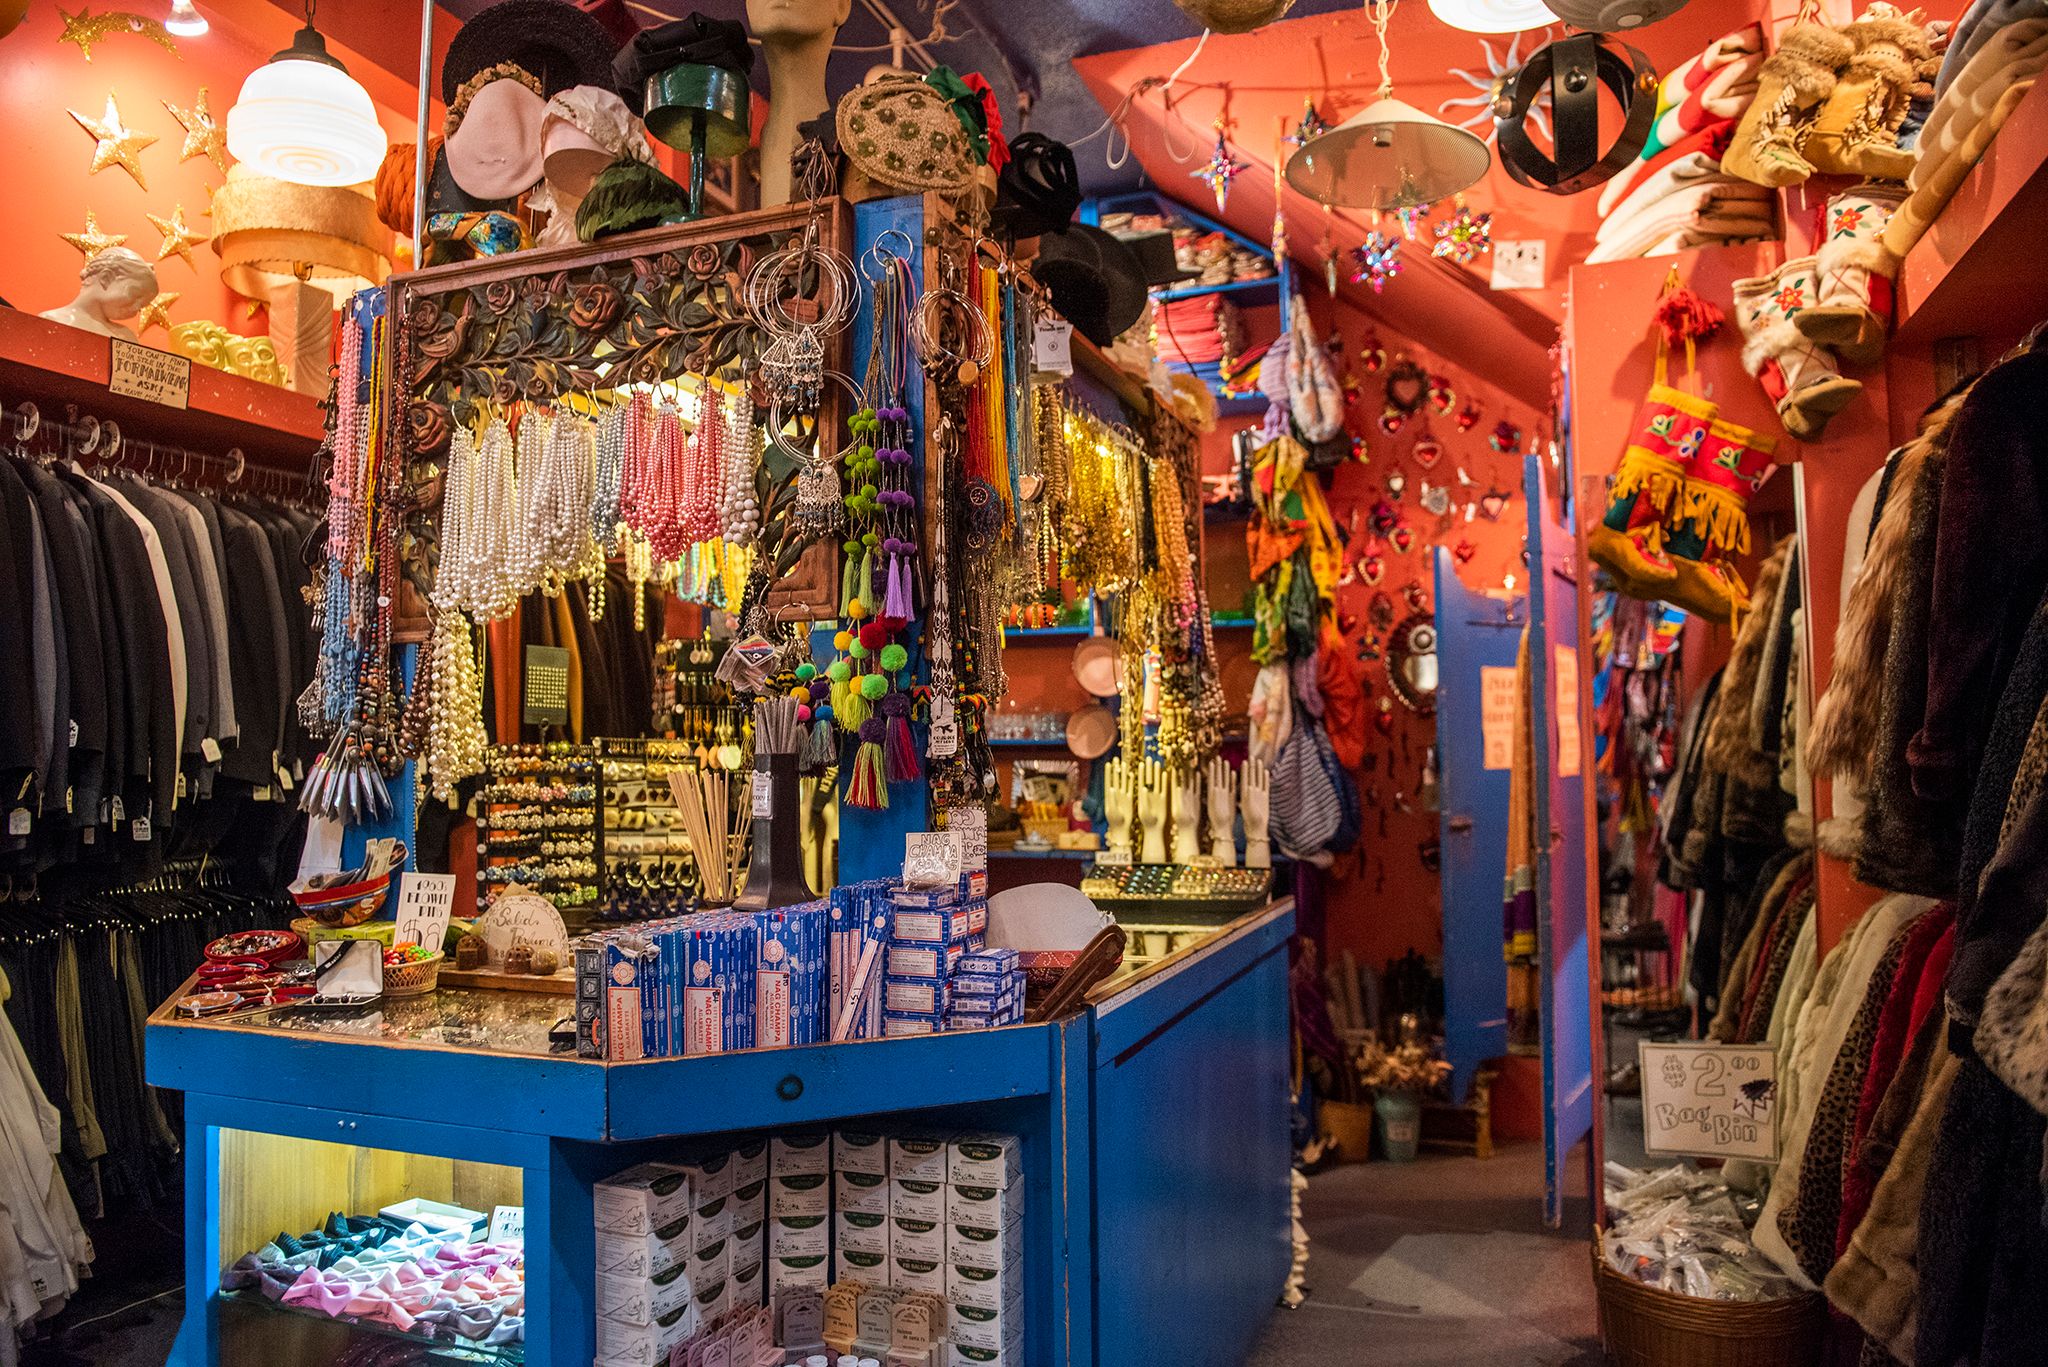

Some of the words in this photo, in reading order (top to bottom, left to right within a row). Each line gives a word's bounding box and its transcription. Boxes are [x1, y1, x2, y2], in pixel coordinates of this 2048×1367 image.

[115, 341, 122, 349] IF
[127, 344, 143, 355] YOU
[145, 350, 167, 361] CAN'T
[169, 357, 187, 367] FIND
[115, 349, 135, 360] YOUR
[137, 355, 154, 366] SIZE
[155, 361, 166, 369] IN
[167, 364, 181, 373] THE
[114, 357, 188, 394] FORMALWEAR
[136, 380, 164, 397] ASK!
[909, 844, 958, 859] CHAMPA
[920, 833, 951, 846] NAG
[495, 906, 539, 928] Solid
[510, 927, 556, 947] Perfume
[617, 997, 625, 1041] CHAMPA
[1655, 1103, 1712, 1133] Bag
[1713, 1114, 1758, 1145] Bin
